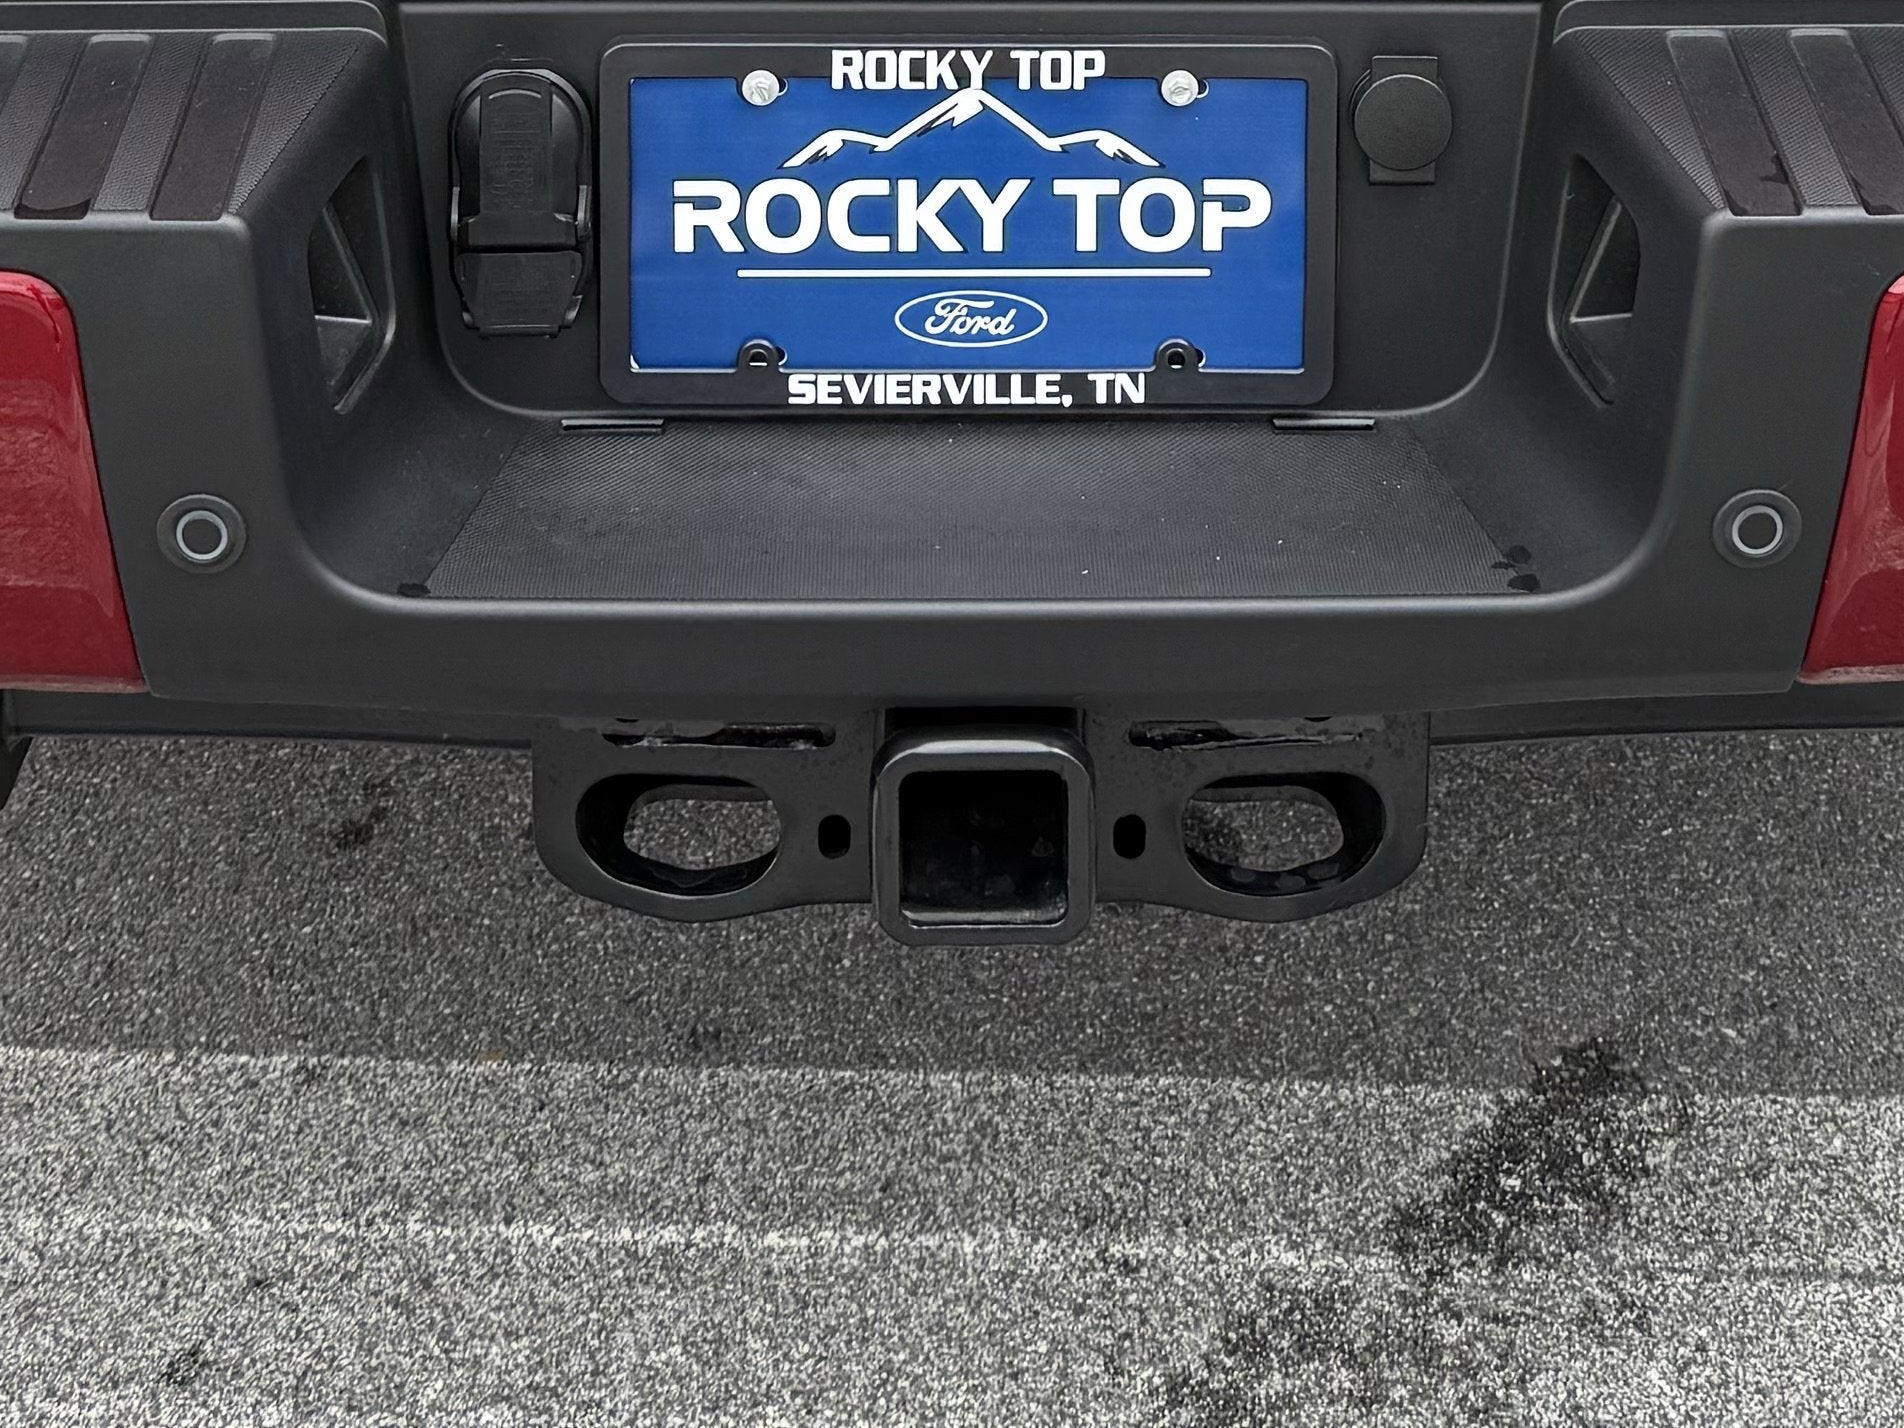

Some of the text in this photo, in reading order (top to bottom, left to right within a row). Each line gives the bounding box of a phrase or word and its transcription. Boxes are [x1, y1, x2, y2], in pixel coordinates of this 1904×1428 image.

[831, 48, 1106, 91] ROCKY TOP
[672, 177, 1273, 254] ROCKY TOP
[924, 297, 1017, 335] Ford
[786, 372, 1147, 408] SEVIERVILLE, TN
